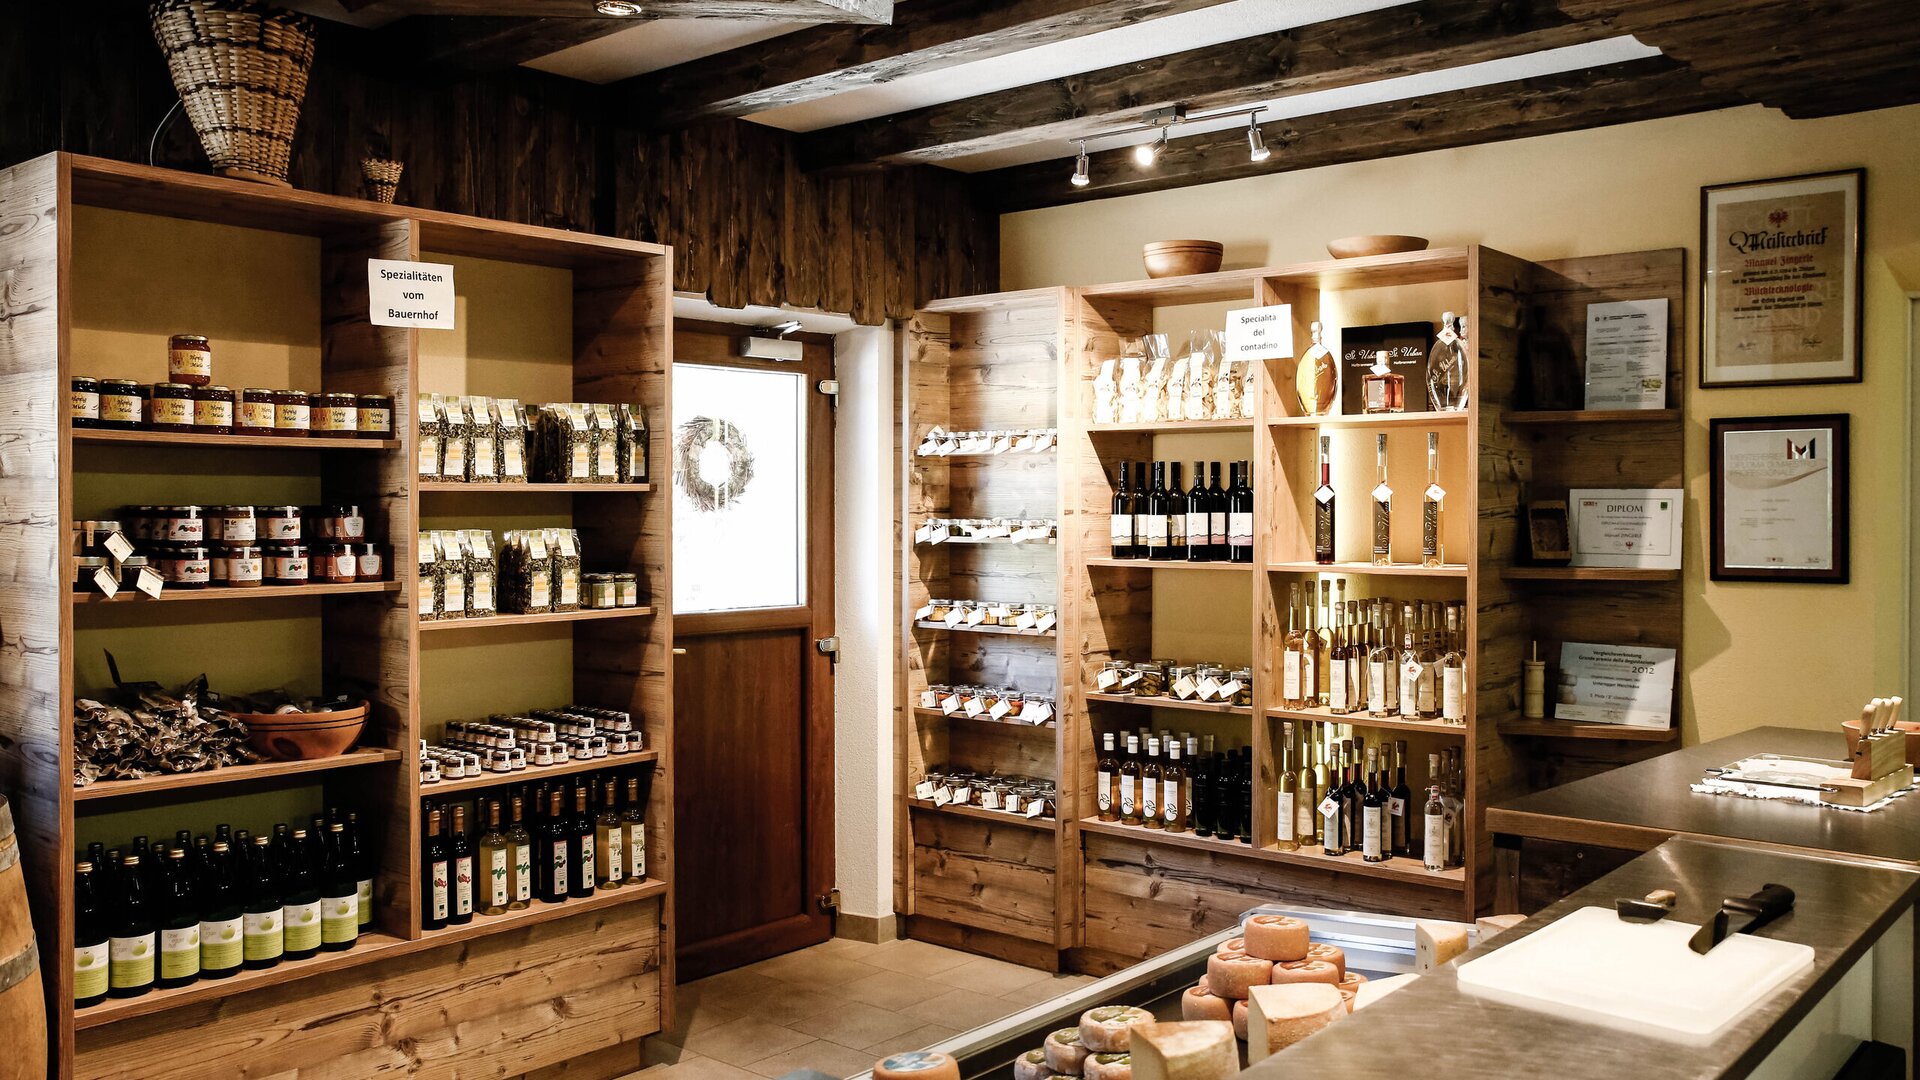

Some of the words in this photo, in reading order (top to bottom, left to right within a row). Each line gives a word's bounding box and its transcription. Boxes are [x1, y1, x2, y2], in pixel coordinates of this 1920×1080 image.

[380, 269, 443, 282] Spezialitäten
[402, 292, 425, 300] vom
[388, 308, 439, 320] Bauernhof
[1240, 314, 1277, 325] Specialità
[1253, 328, 1265, 336] del
[1240, 341, 1279, 351] contadino
[1400, 346, 1423, 357] Urban
[1606, 504, 1644, 513] DIPLOM
[1632, 666, 1655, 675] 2012
